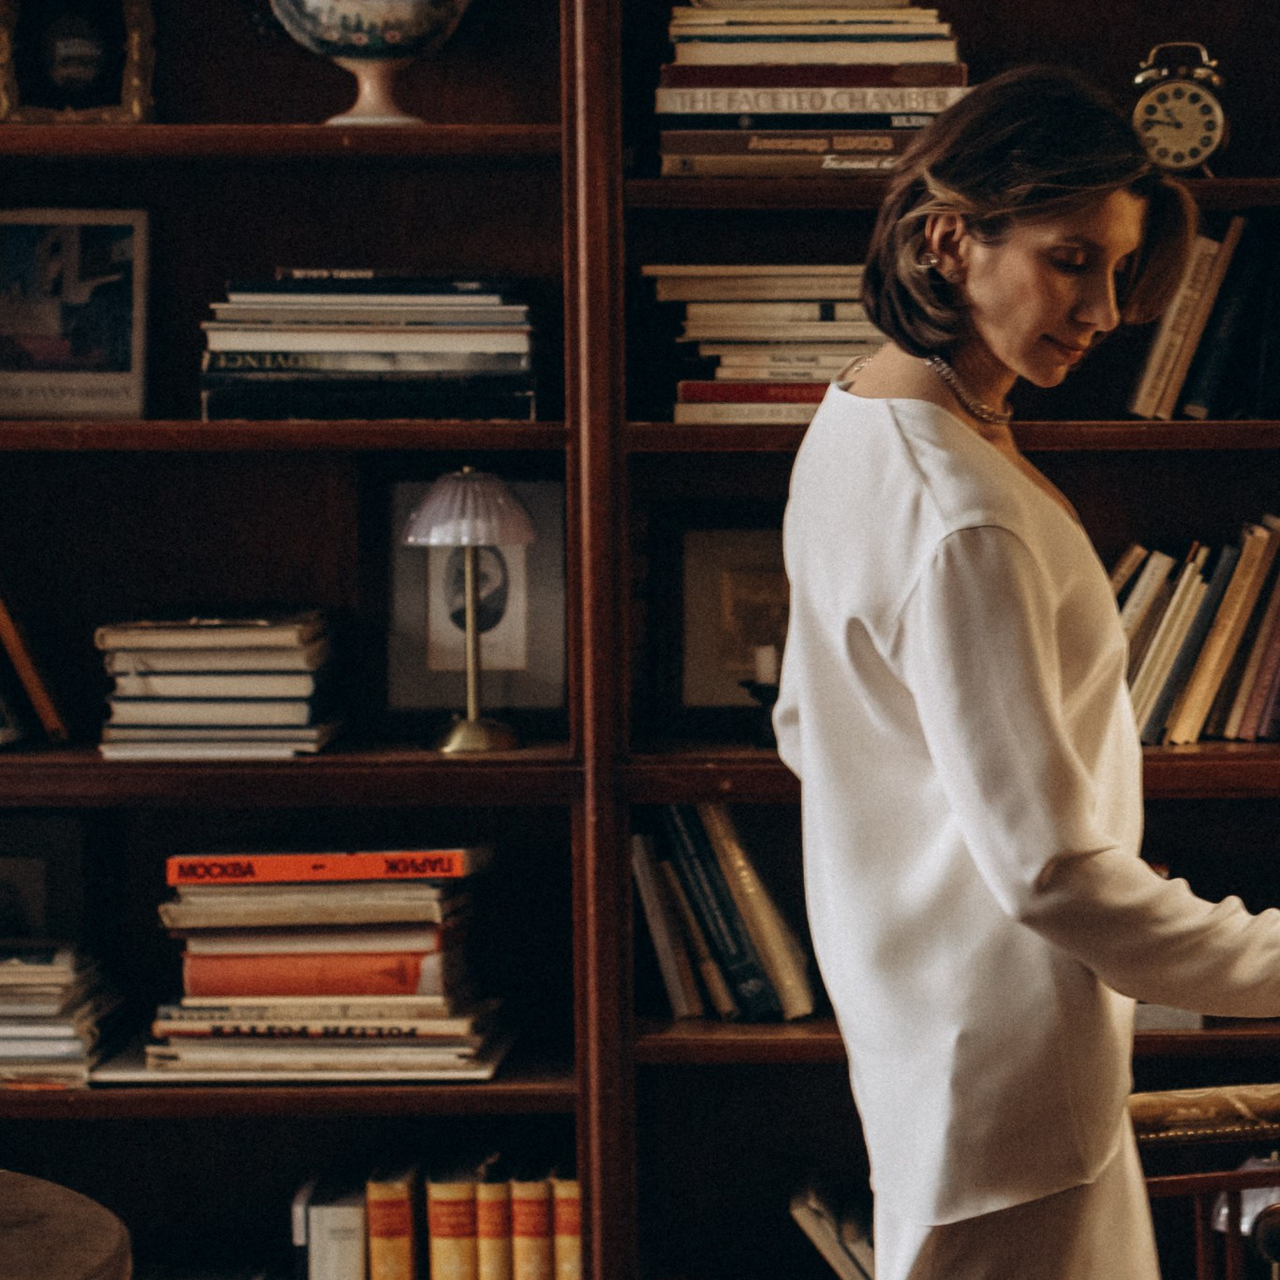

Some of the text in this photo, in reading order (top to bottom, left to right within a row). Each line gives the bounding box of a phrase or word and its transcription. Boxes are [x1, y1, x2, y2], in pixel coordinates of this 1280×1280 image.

[678, 90, 949, 111] THE FACETED CHAMBER
[177, 858, 454, 879] МОСКВА ПАРИЖ
